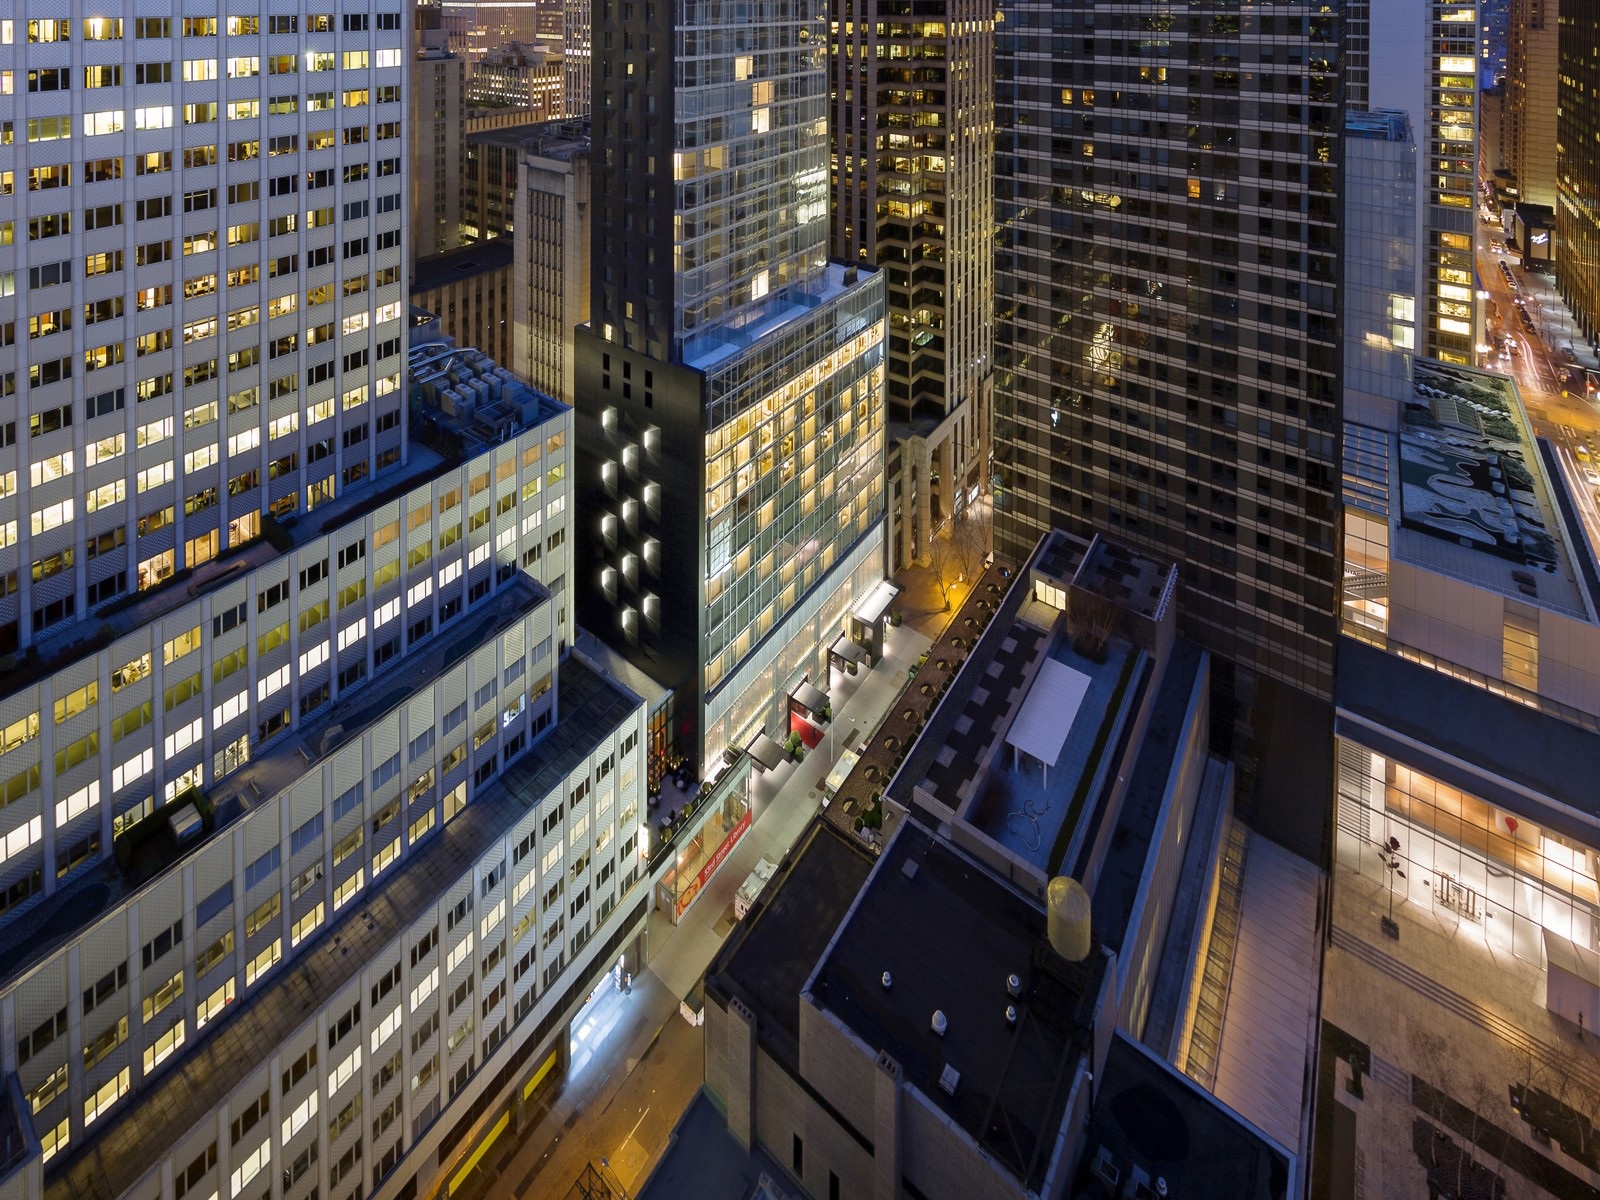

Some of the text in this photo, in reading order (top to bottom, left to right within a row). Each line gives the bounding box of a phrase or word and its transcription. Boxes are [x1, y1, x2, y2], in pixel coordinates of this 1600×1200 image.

[704, 858, 716, 878] 53rd
[715, 841, 730, 862] Street
[730, 820, 746, 844] Library
